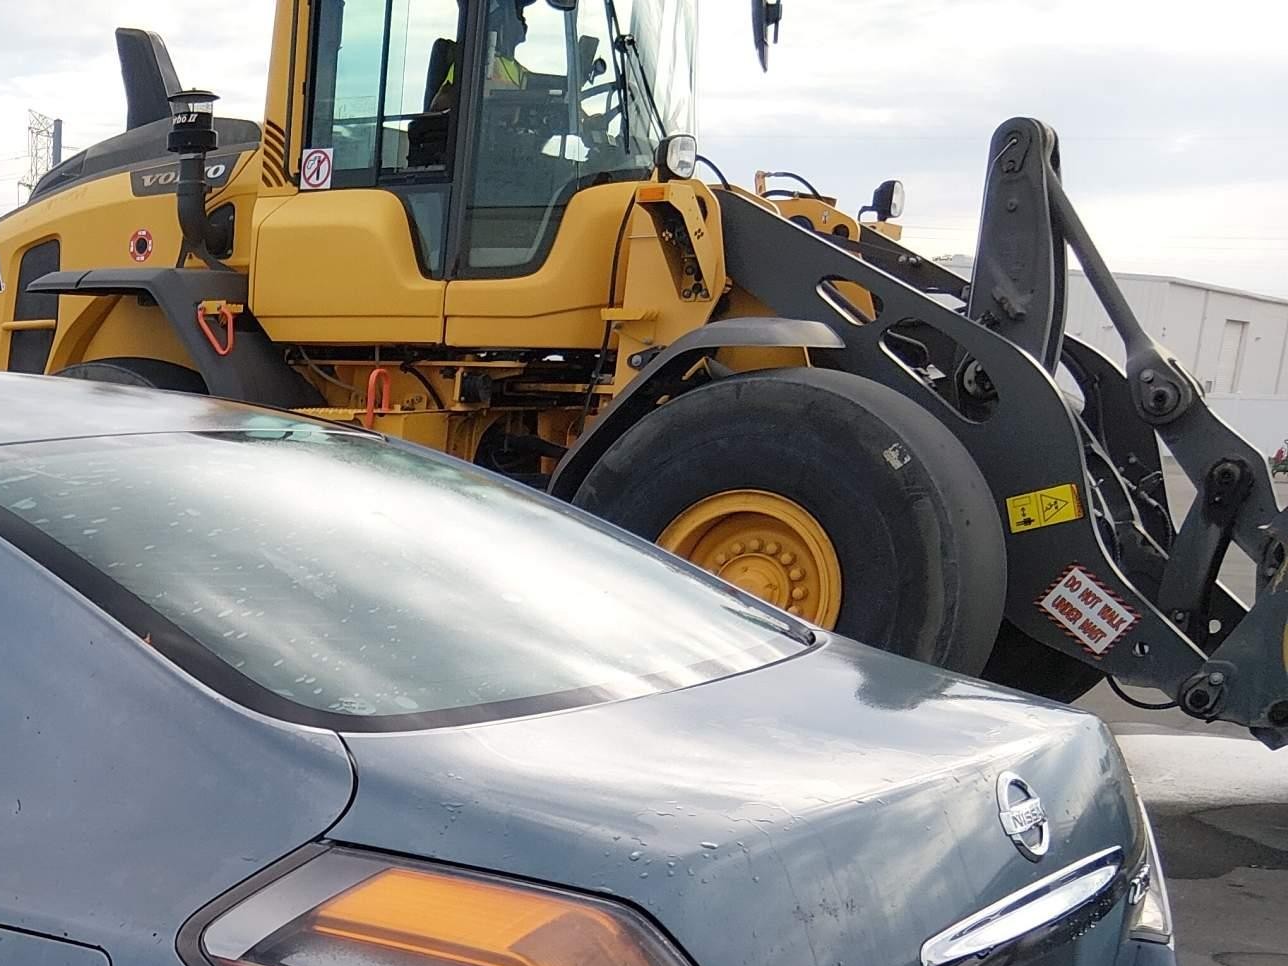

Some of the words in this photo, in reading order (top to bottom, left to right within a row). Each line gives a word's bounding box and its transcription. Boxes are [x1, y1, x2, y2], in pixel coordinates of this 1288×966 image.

[141, 164, 226, 187] VOO
[1051, 594, 1083, 625] UNDER
[1064, 575, 1083, 593] DO
[1078, 587, 1103, 609] NOT
[1097, 603, 1128, 632] WALK
